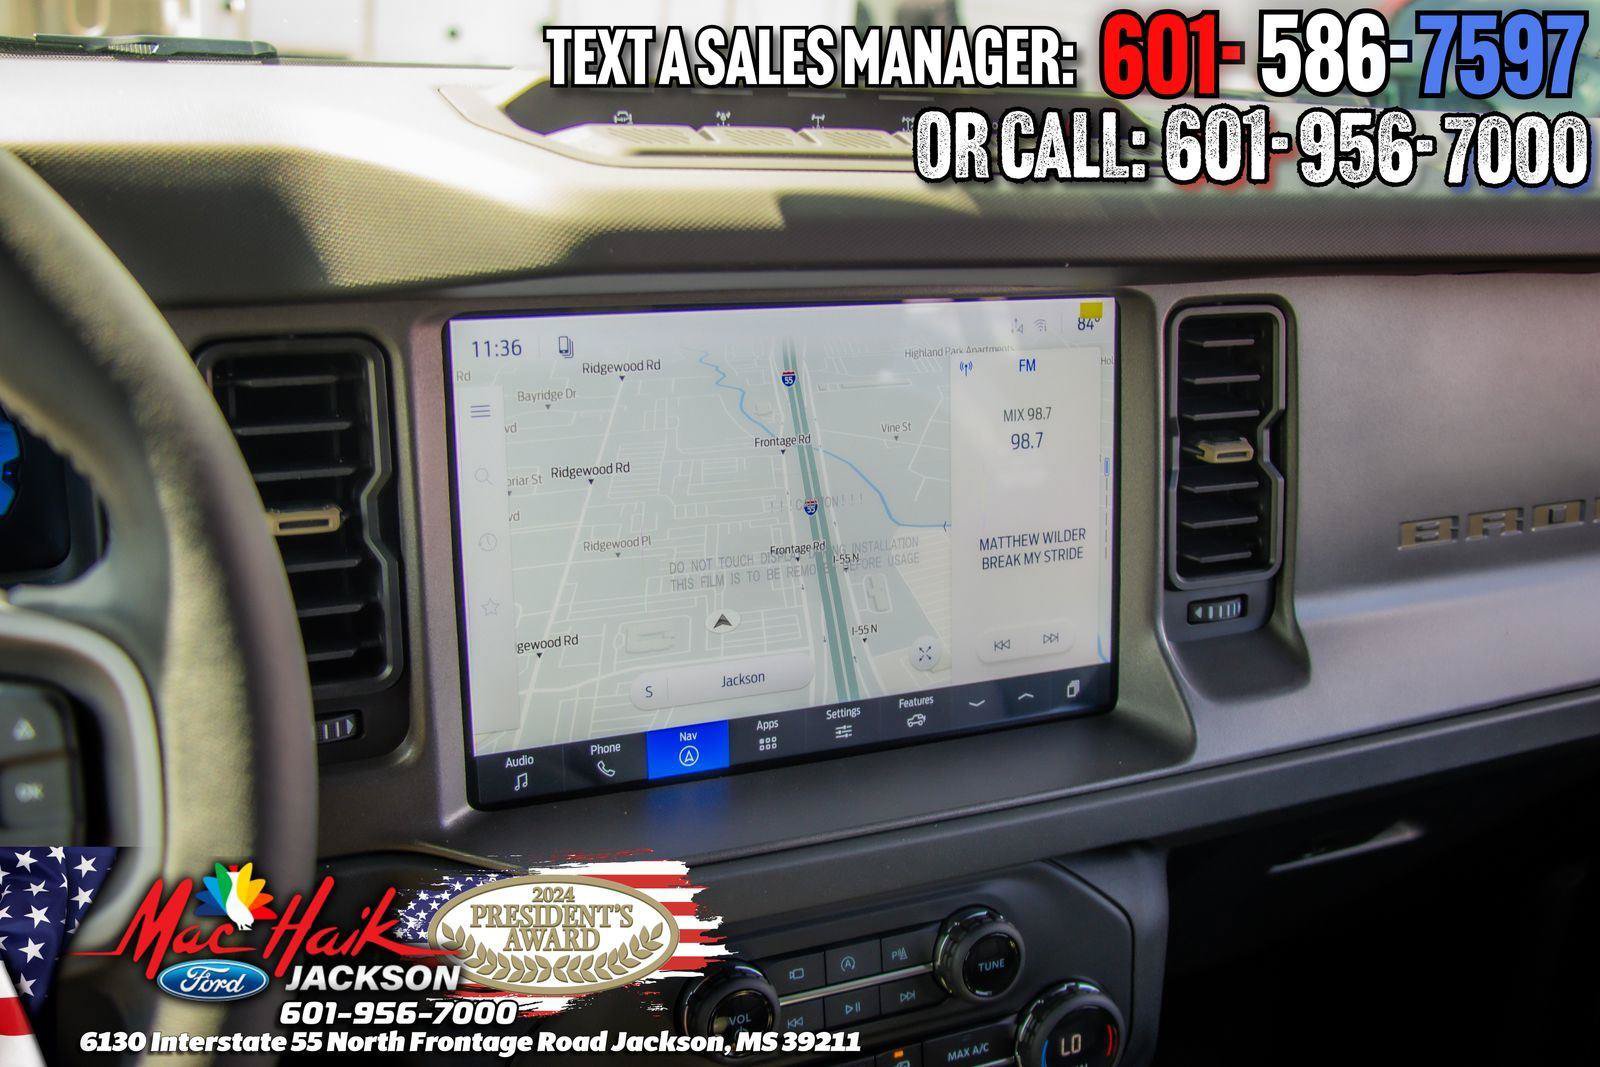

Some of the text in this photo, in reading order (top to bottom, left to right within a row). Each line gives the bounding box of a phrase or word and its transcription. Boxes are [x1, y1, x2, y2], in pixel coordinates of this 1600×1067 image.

[471, 339, 523, 358] 11:36
[904, 345, 944, 359] Highland
[582, 359, 661, 377] Ridgewood Rd
[1018, 358, 1037, 373] FM
[456, 370, 471, 382] Rd
[517, 388, 577, 404] Bayridge Dr
[1003, 406, 1052, 422] MIX 98.7
[881, 421, 912, 433] Vine St
[754, 434, 811, 448] Frontage Rd
[1011, 431, 1044, 450] 98.7
[551, 461, 631, 479] Ridgewood Rd
[531, 474, 542, 485] St
[1398, 497, 1600, 550] BRO
[583, 535, 651, 552] Ridgewood Pl
[770, 540, 826, 555] Frontage Rd
[979, 528, 1087, 551] MATTHEW WILDER
[669, 561, 685, 575] DO
[692, 559, 713, 573] NOT
[720, 555, 754, 571] TOUCH
[851, 537, 919, 555] INSTALLATION
[852, 552, 860, 563] N
[982, 547, 1084, 570] BREAK MY STRIDE
[670, 578, 695, 592] THIS
[700, 575, 725, 590] FILM
[730, 572, 741, 585] IS
[747, 570, 761, 583] TO
[767, 568, 782, 581] BE
[888, 552, 920, 566] USAGE
[851, 624, 878, 636] I-55 N
[516, 634, 579, 654] gewood Rd
[721, 671, 766, 688] Jackson
[645, 685, 653, 698] S
[899, 695, 934, 710] Features
[825, 705, 861, 721] Settings
[756, 718, 779, 732] Apps
[679, 731, 697, 742] Nav
[590, 742, 621, 755] Phone
[505, 755, 534, 769] Audio
[977, 957, 1006, 973] TUNE
[728, 1012, 752, 1026] VOL
[947, 1041, 990, 1062] MAX A/C
[1060, 1033, 1082, 1058] LO
